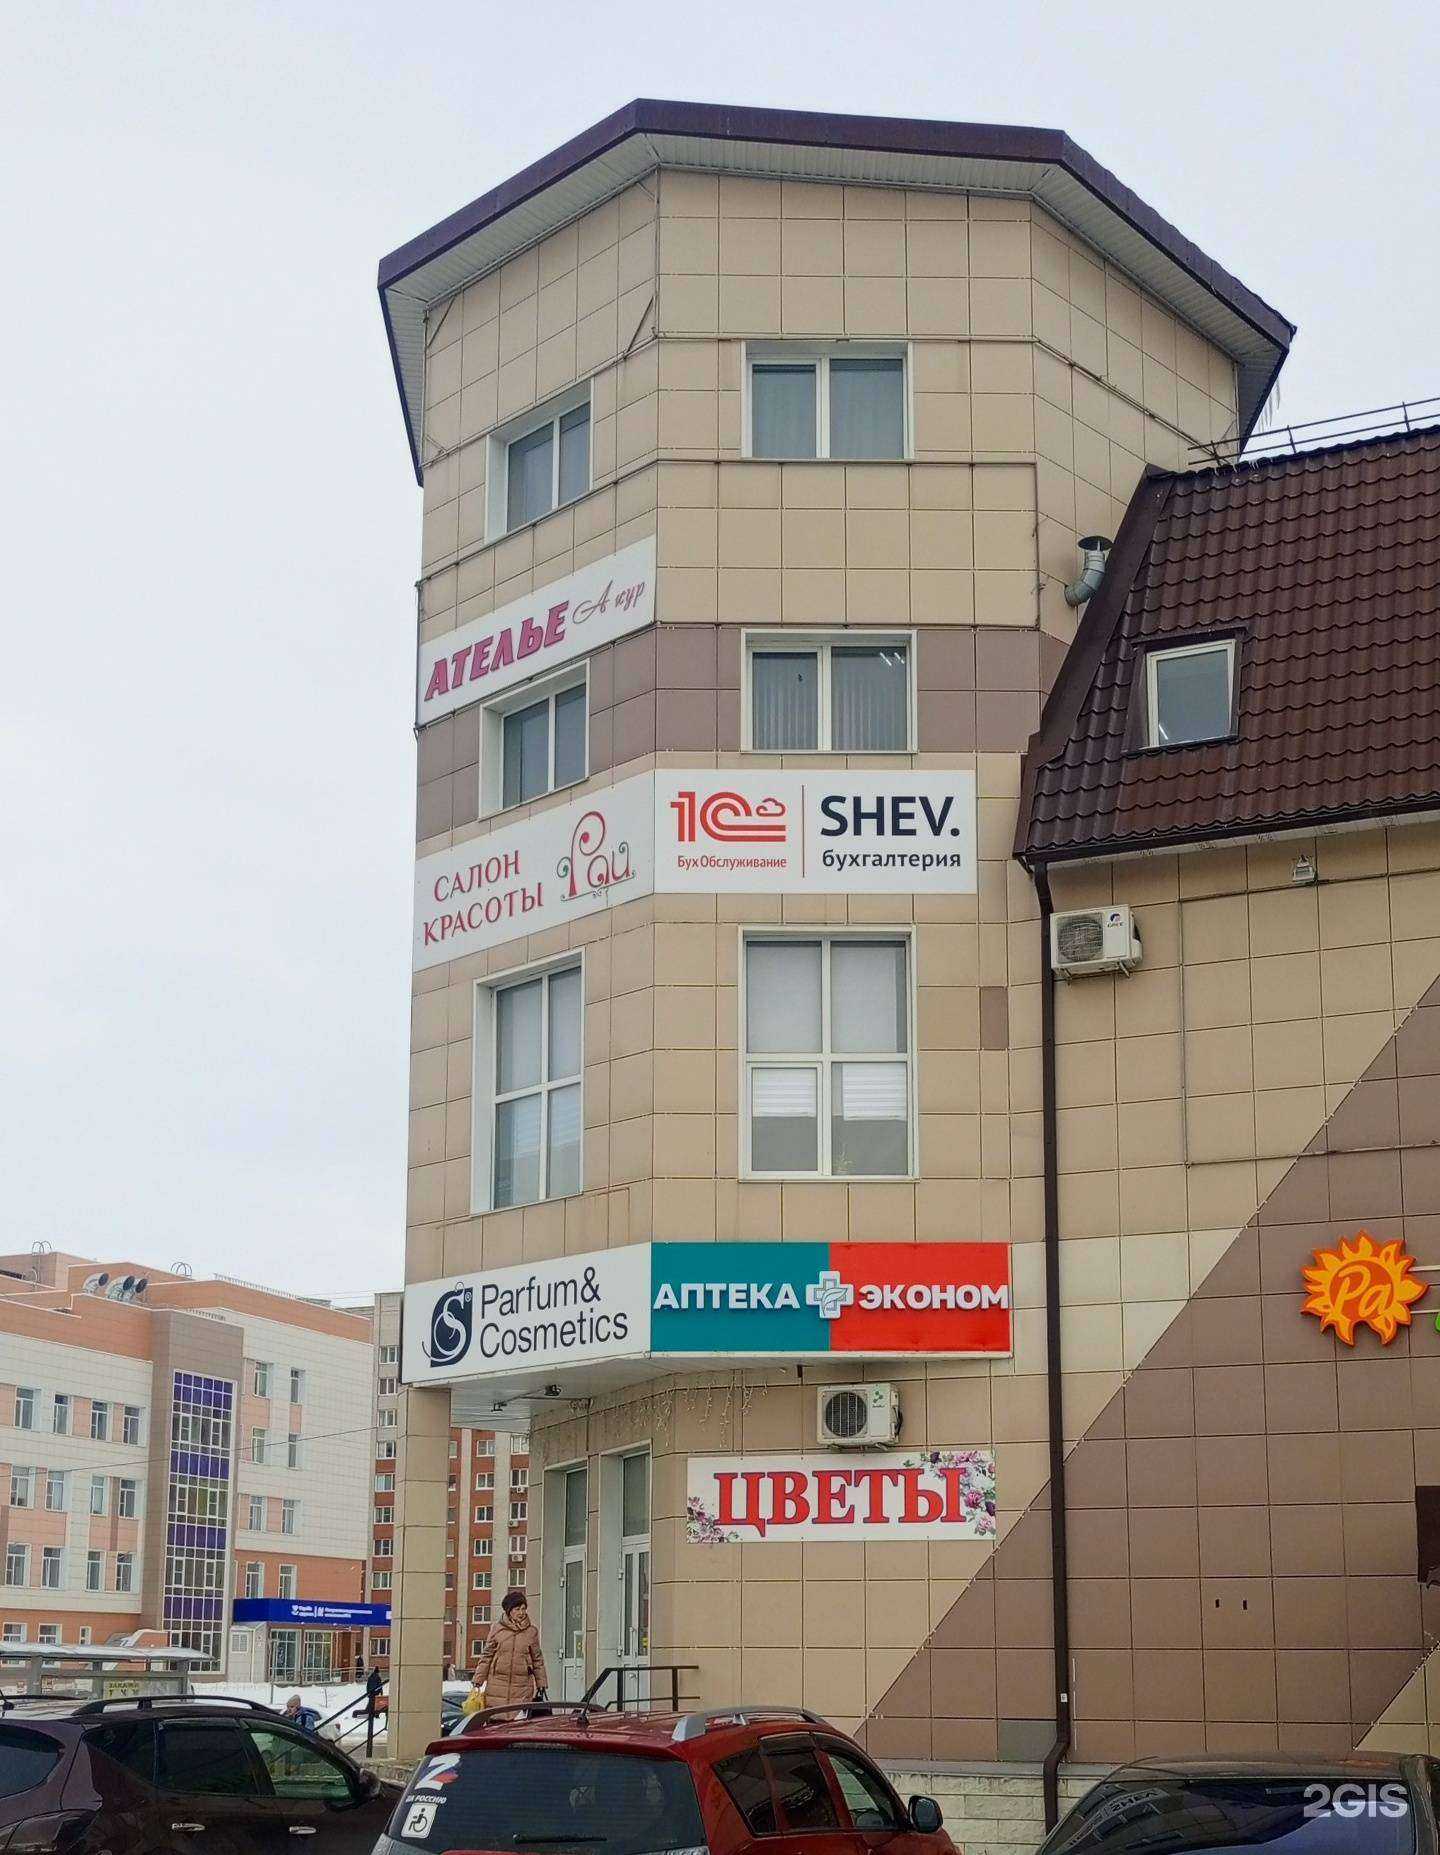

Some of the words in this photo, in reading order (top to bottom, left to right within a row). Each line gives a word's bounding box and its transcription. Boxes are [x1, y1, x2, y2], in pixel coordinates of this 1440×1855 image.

[424, 600, 570, 701] АТЕЛЬЕ
[820, 795, 960, 837] SHEV.
[434, 850, 520, 902] САЛОН
[822, 850, 961, 871] бухгалтерия
[423, 882, 544, 946] КРАСОТЫ
[480, 1266, 602, 1320] Parfum&
[652, 1283, 801, 1310] АПТЕКА
[858, 1284, 1010, 1310] ЭКОНОМ
[479, 1307, 628, 1358] Cosmetics
[713, 1467, 967, 1538] ЦВЕТЫ
